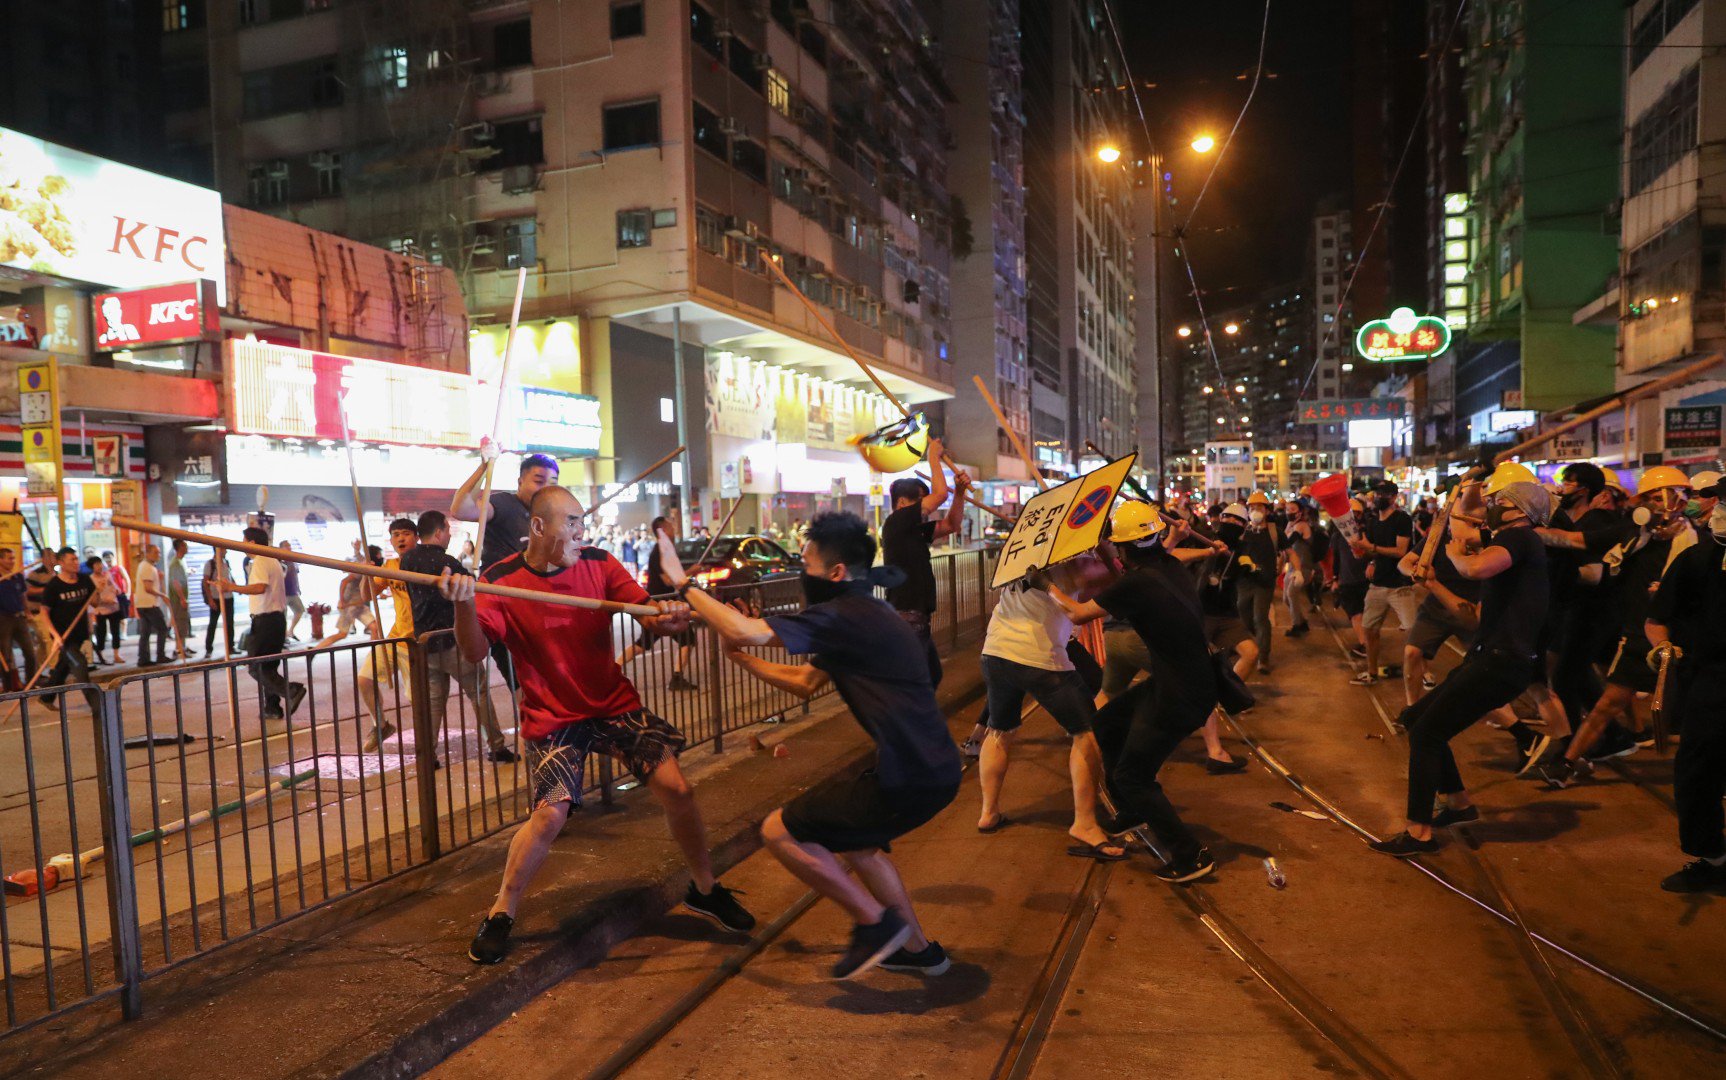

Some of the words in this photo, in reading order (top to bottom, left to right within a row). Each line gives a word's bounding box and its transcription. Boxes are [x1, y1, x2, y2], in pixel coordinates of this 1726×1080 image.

[106, 215, 208, 272] KFC
[149, 298, 196, 325] KFC
[184, 455, 212, 474] 六福
[1004, 505, 1045, 566] 終止
